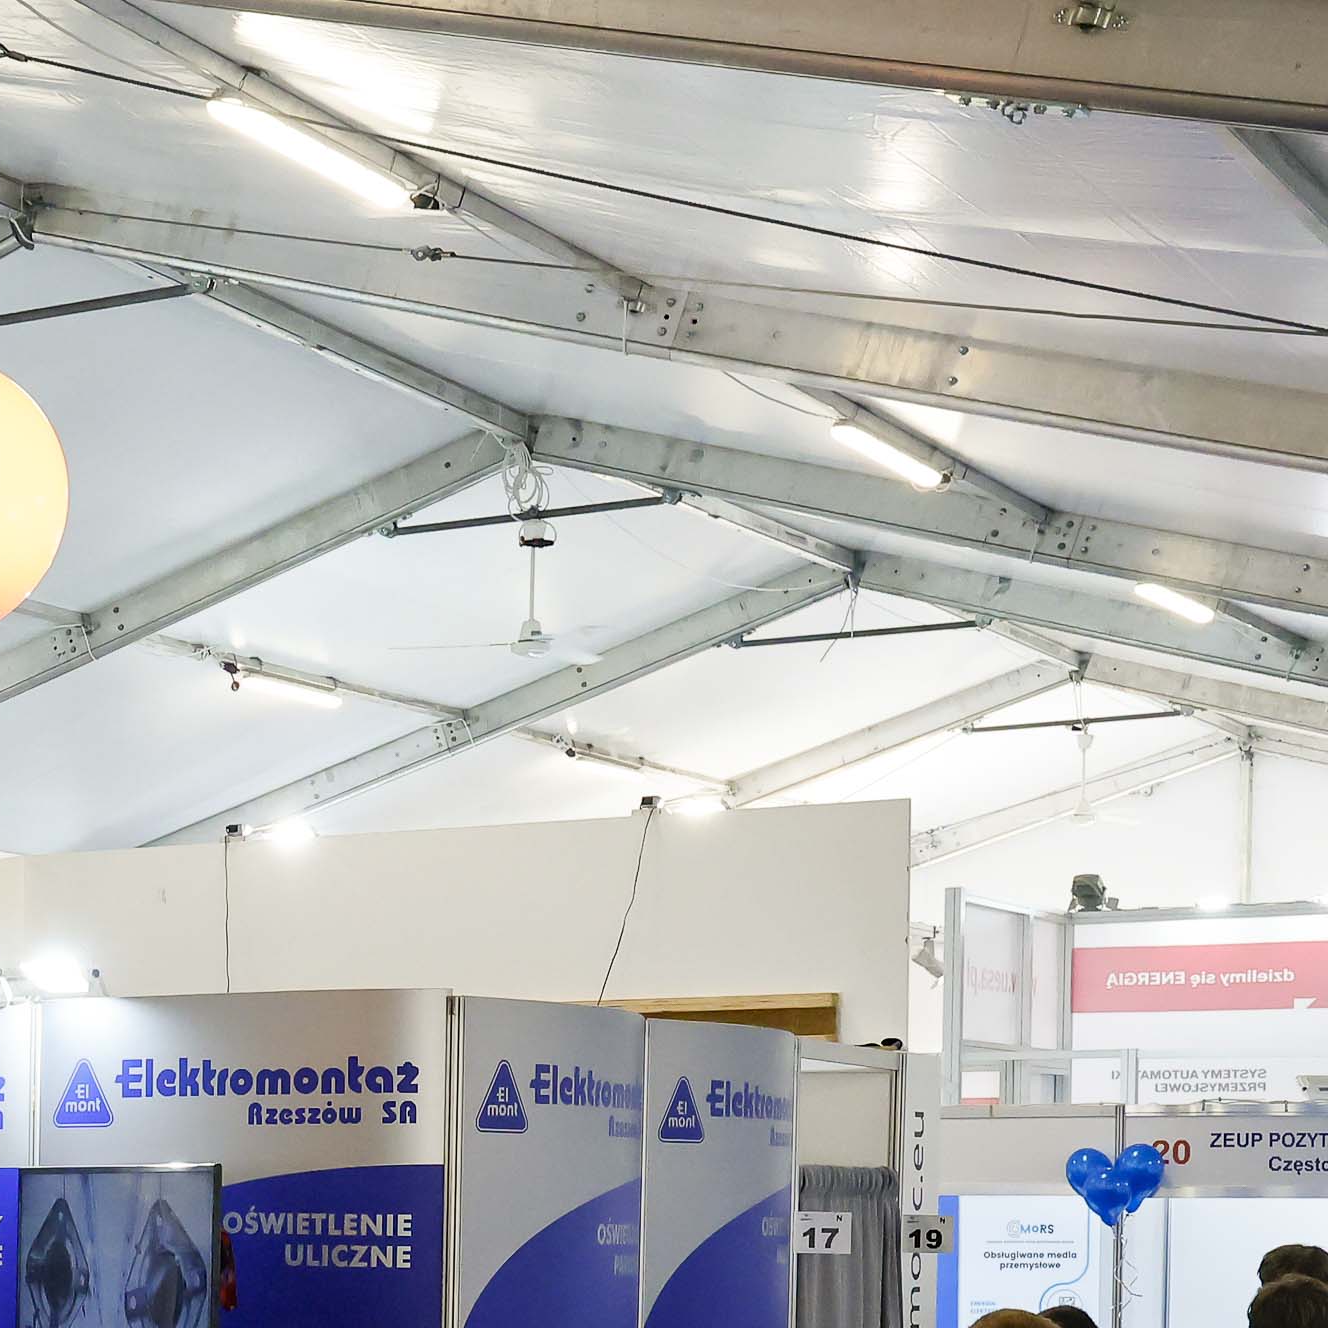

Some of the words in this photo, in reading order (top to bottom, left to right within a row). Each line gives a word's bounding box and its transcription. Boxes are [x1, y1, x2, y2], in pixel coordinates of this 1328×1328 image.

[114, 1056, 419, 1098] Elektromontaż
[65, 1099, 101, 1113] mont
[248, 1101, 361, 1125] Rzeszów
[382, 1101, 417, 1124] SA
[487, 1102, 518, 1117] mont
[668, 1115, 695, 1129] mont
[1210, 1133, 1263, 1148] ZEUP
[223, 1206, 412, 1236] OŚWIETLENIE
[802, 1228, 839, 1249] 17
[909, 1229, 943, 1249] 19
[285, 1245, 411, 1268] ULICZNE
[984, 1251, 1044, 1261] Obsługiwane
[1000, 1261, 1061, 1271] przemysłowe
